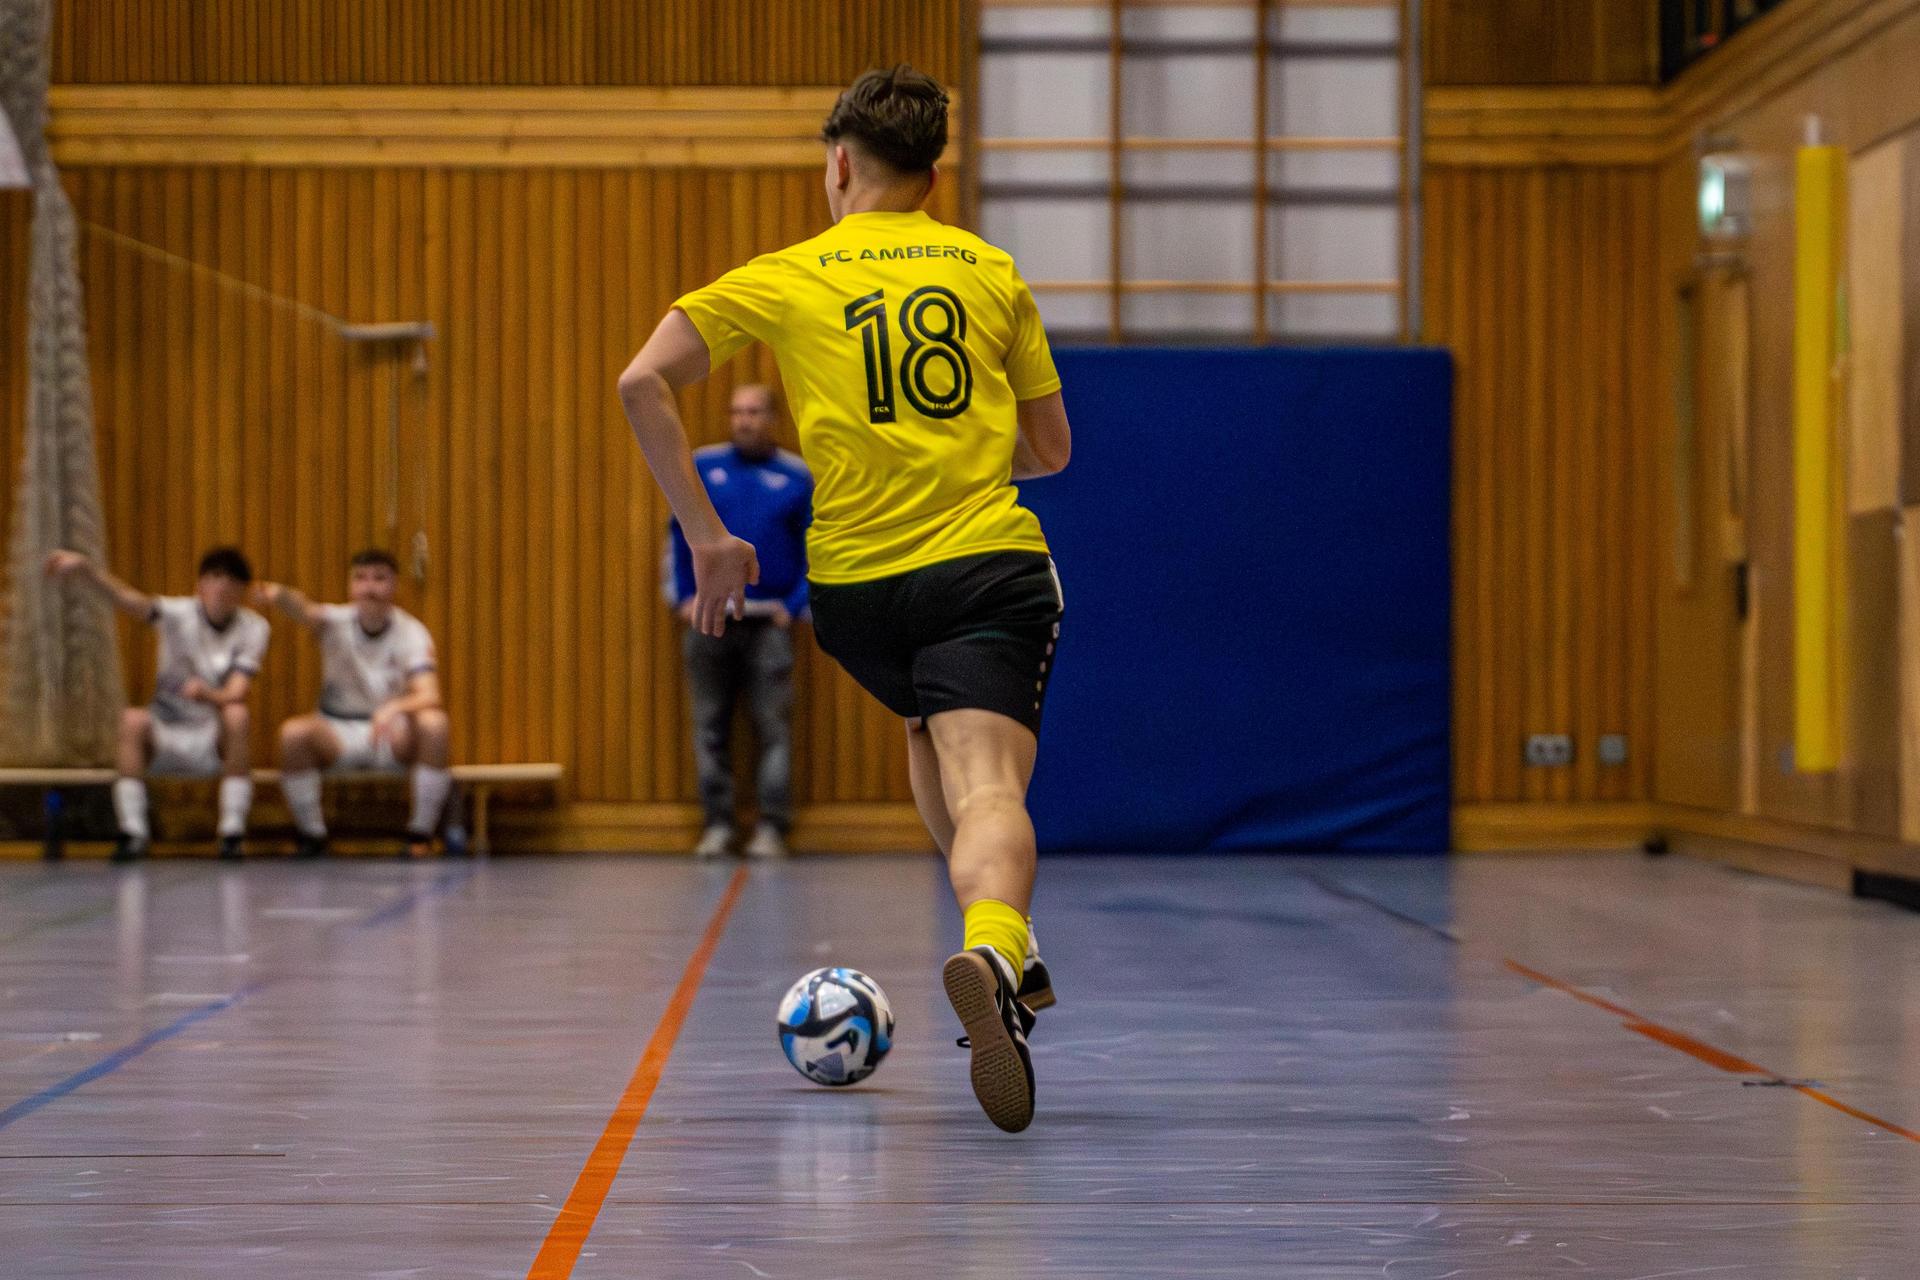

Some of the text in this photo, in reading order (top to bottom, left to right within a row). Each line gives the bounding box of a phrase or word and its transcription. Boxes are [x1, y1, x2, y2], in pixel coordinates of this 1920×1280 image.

[819, 245, 977, 267] FC AMBERG
[844, 285, 973, 424] 18
